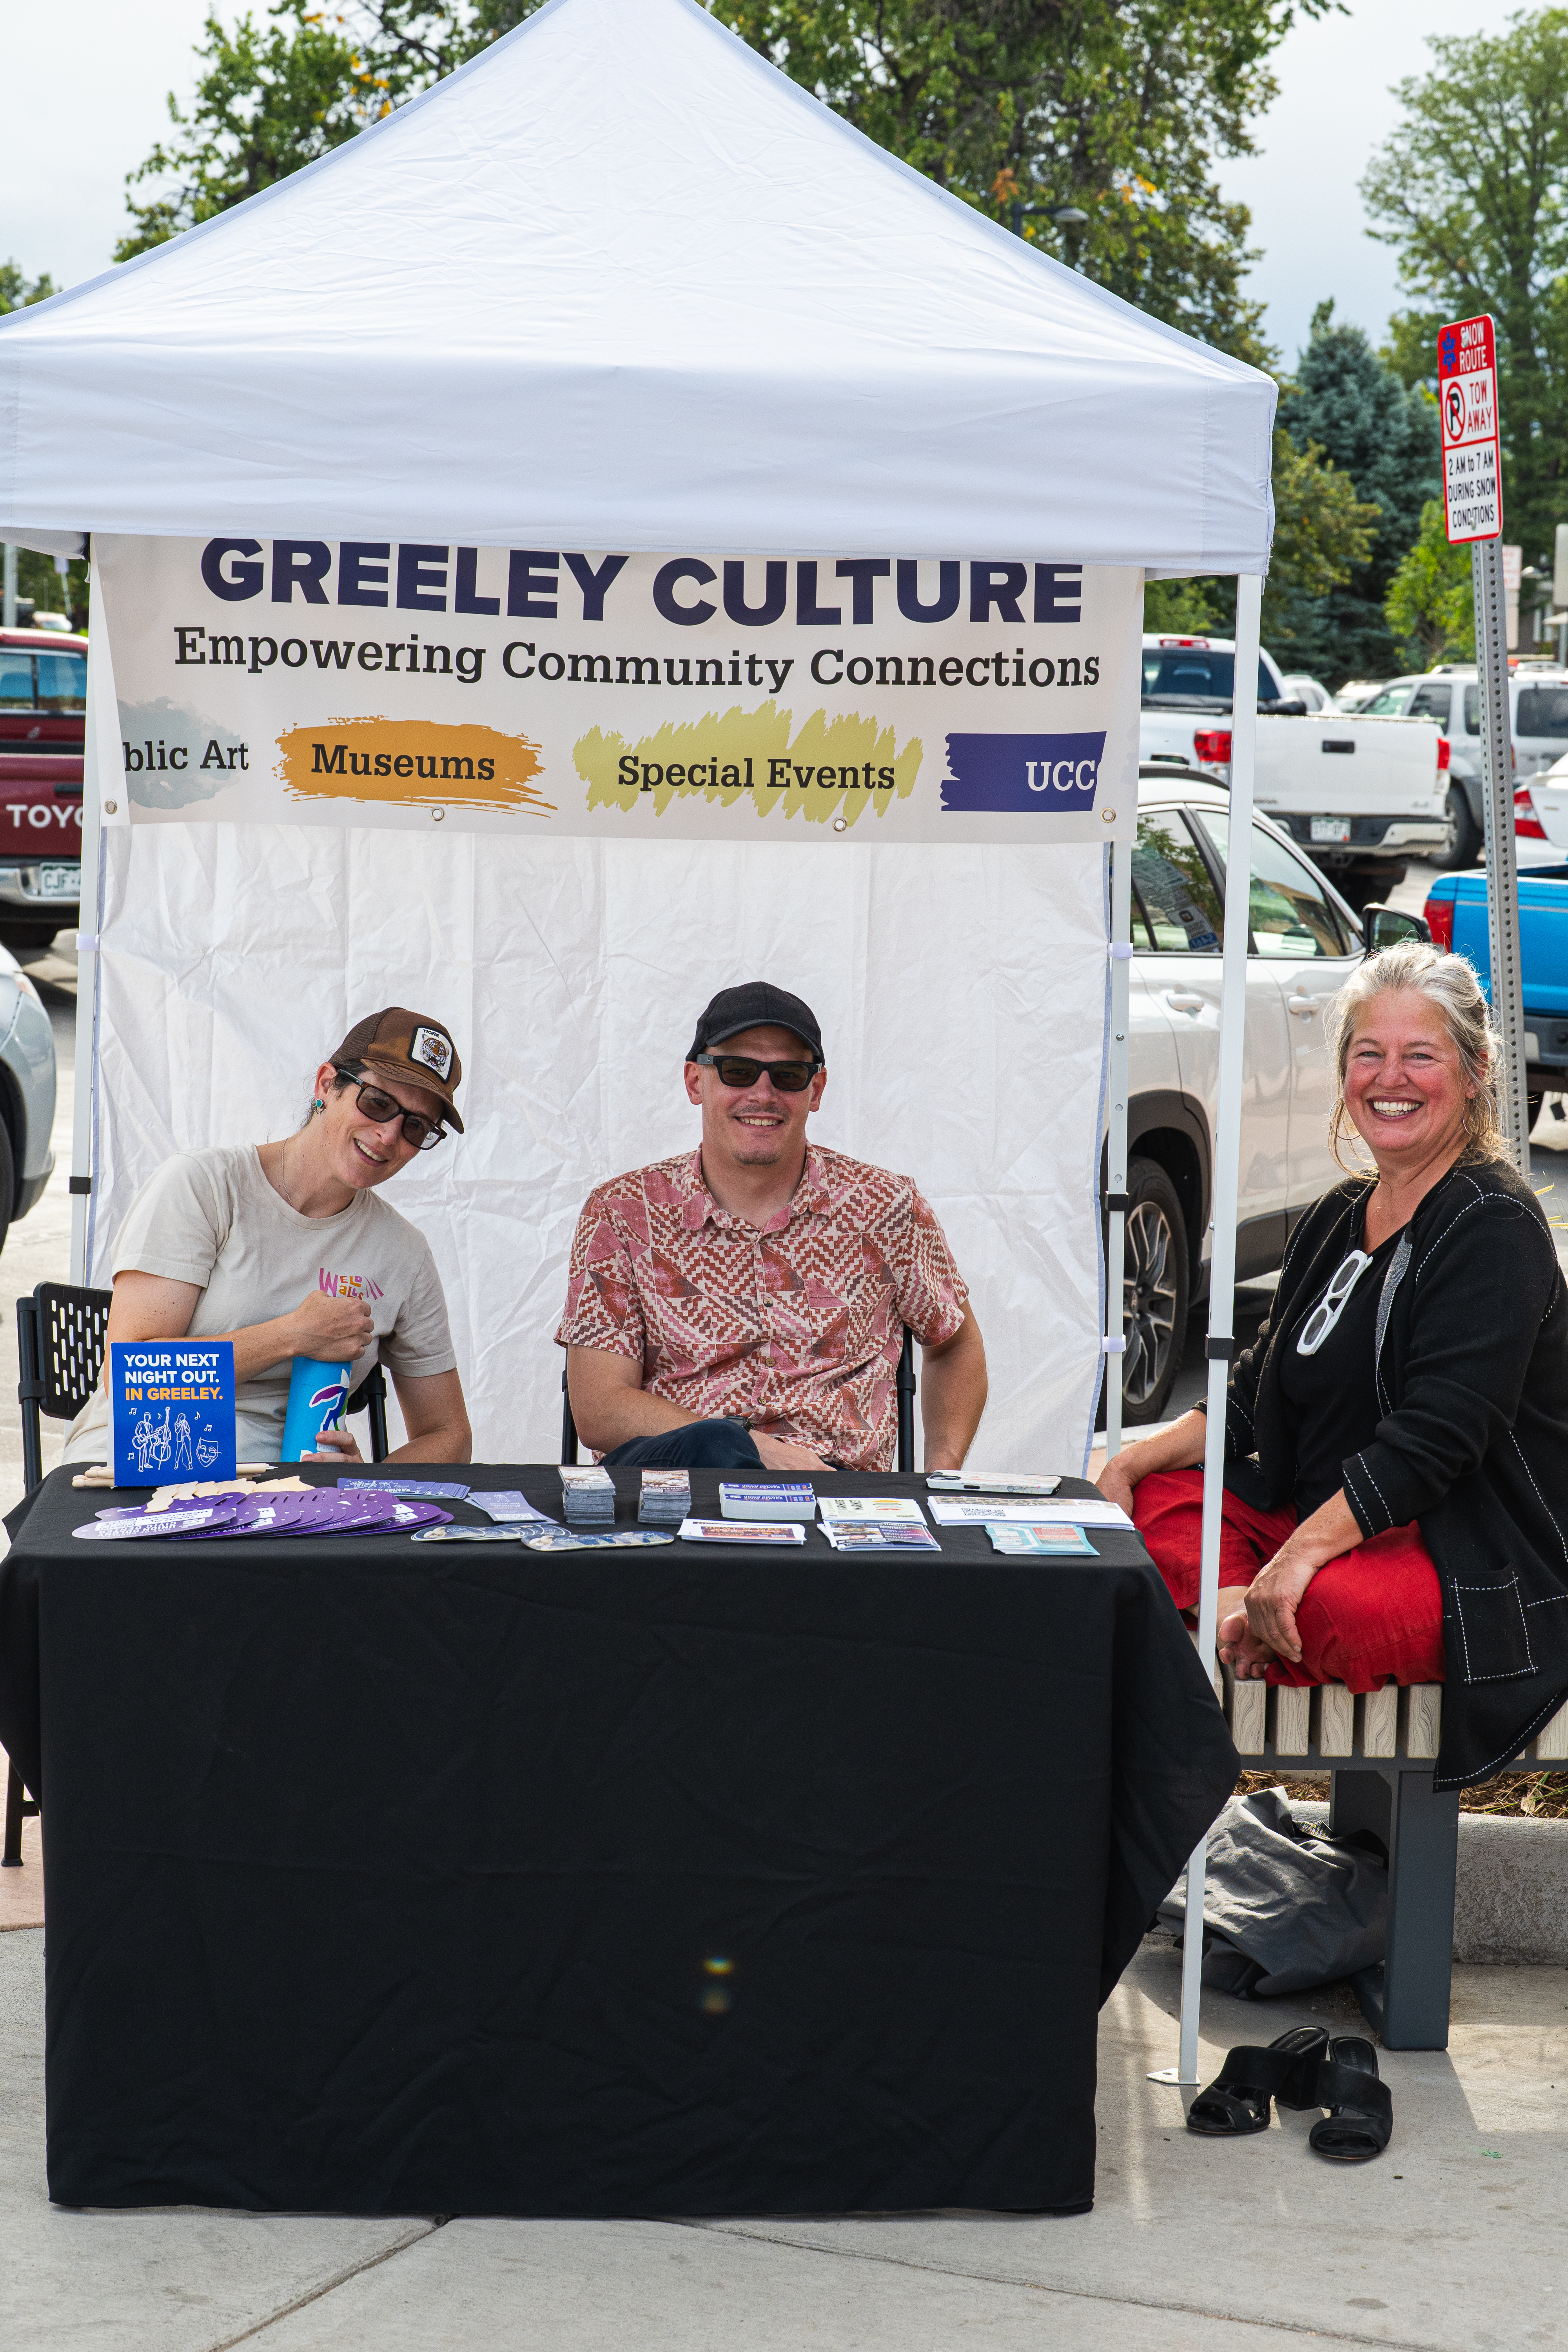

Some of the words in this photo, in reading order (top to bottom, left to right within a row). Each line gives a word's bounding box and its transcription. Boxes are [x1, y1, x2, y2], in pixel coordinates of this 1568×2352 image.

[1460, 321, 1484, 348] SNOW
[1459, 345, 1487, 373] ROUTE
[1470, 380, 1487, 404] TOW
[1467, 407, 1492, 434] AWAY
[1448, 458, 1453, 475] 2
[1455, 455, 1466, 475] AM
[1468, 455, 1474, 472] to
[1476, 452, 1480, 470] 7
[1483, 450, 1494, 469] AM
[1448, 481, 1474, 502] DURING
[1477, 476, 1495, 497] SNOW
[201, 538, 630, 621] GREELEY
[653, 558, 1083, 627] CULTURE
[174, 627, 486, 684] Empowering
[503, 642, 795, 694] Community
[811, 648, 1100, 687] Connections
[200, 740, 249, 770] Art
[311, 743, 495, 780] Museums
[618, 755, 755, 792] Special
[766, 759, 895, 789] Events
[1026, 760, 1101, 791] UCC
[423, 1029, 439, 1038] TIGRE
[124, 1354, 171, 1367] YOUR
[176, 1354, 219, 1366] NEXT
[125, 1371, 177, 1383] NIGHT
[181, 1370, 219, 1383] OUT.
[126, 1388, 142, 1400] IN
[147, 1387, 223, 1400] GREELEY.
[98, 1526, 142, 1534] CENTER
